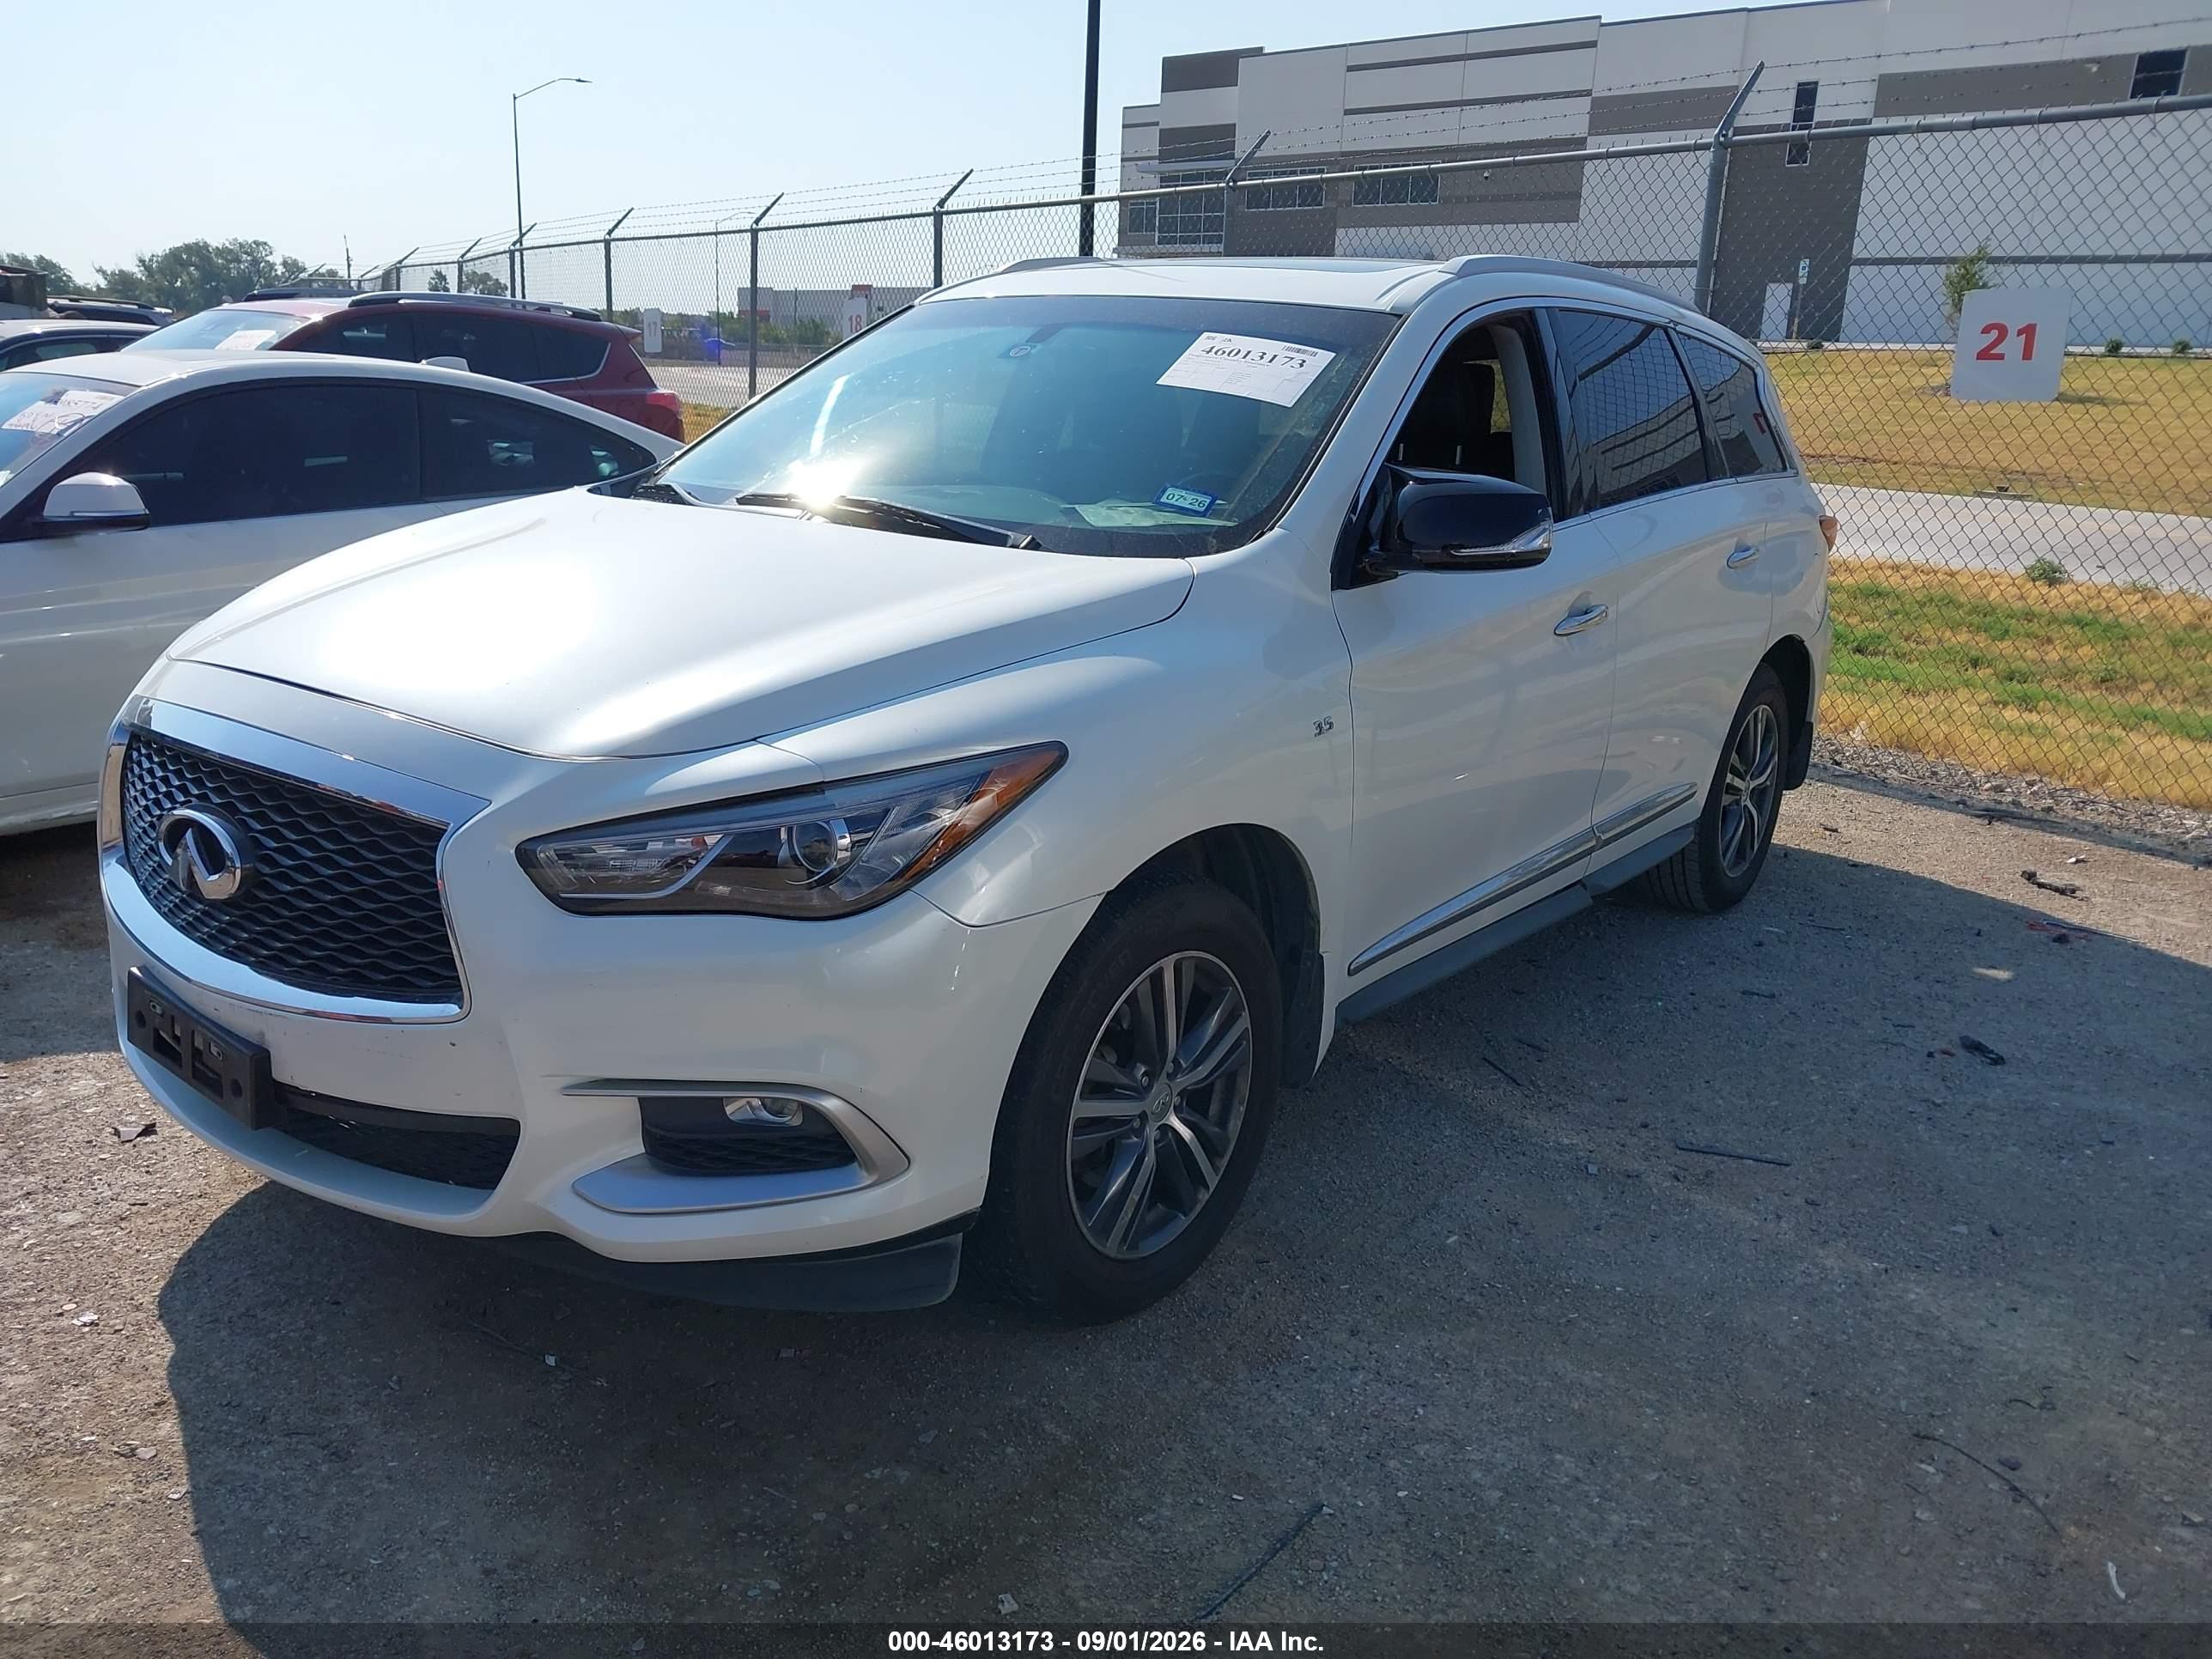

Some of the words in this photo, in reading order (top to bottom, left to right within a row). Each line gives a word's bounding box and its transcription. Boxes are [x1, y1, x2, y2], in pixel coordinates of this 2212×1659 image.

[848, 314, 862, 333] 18
[1976, 322, 2038, 361] 21
[1200, 344, 1308, 369] 46013173
